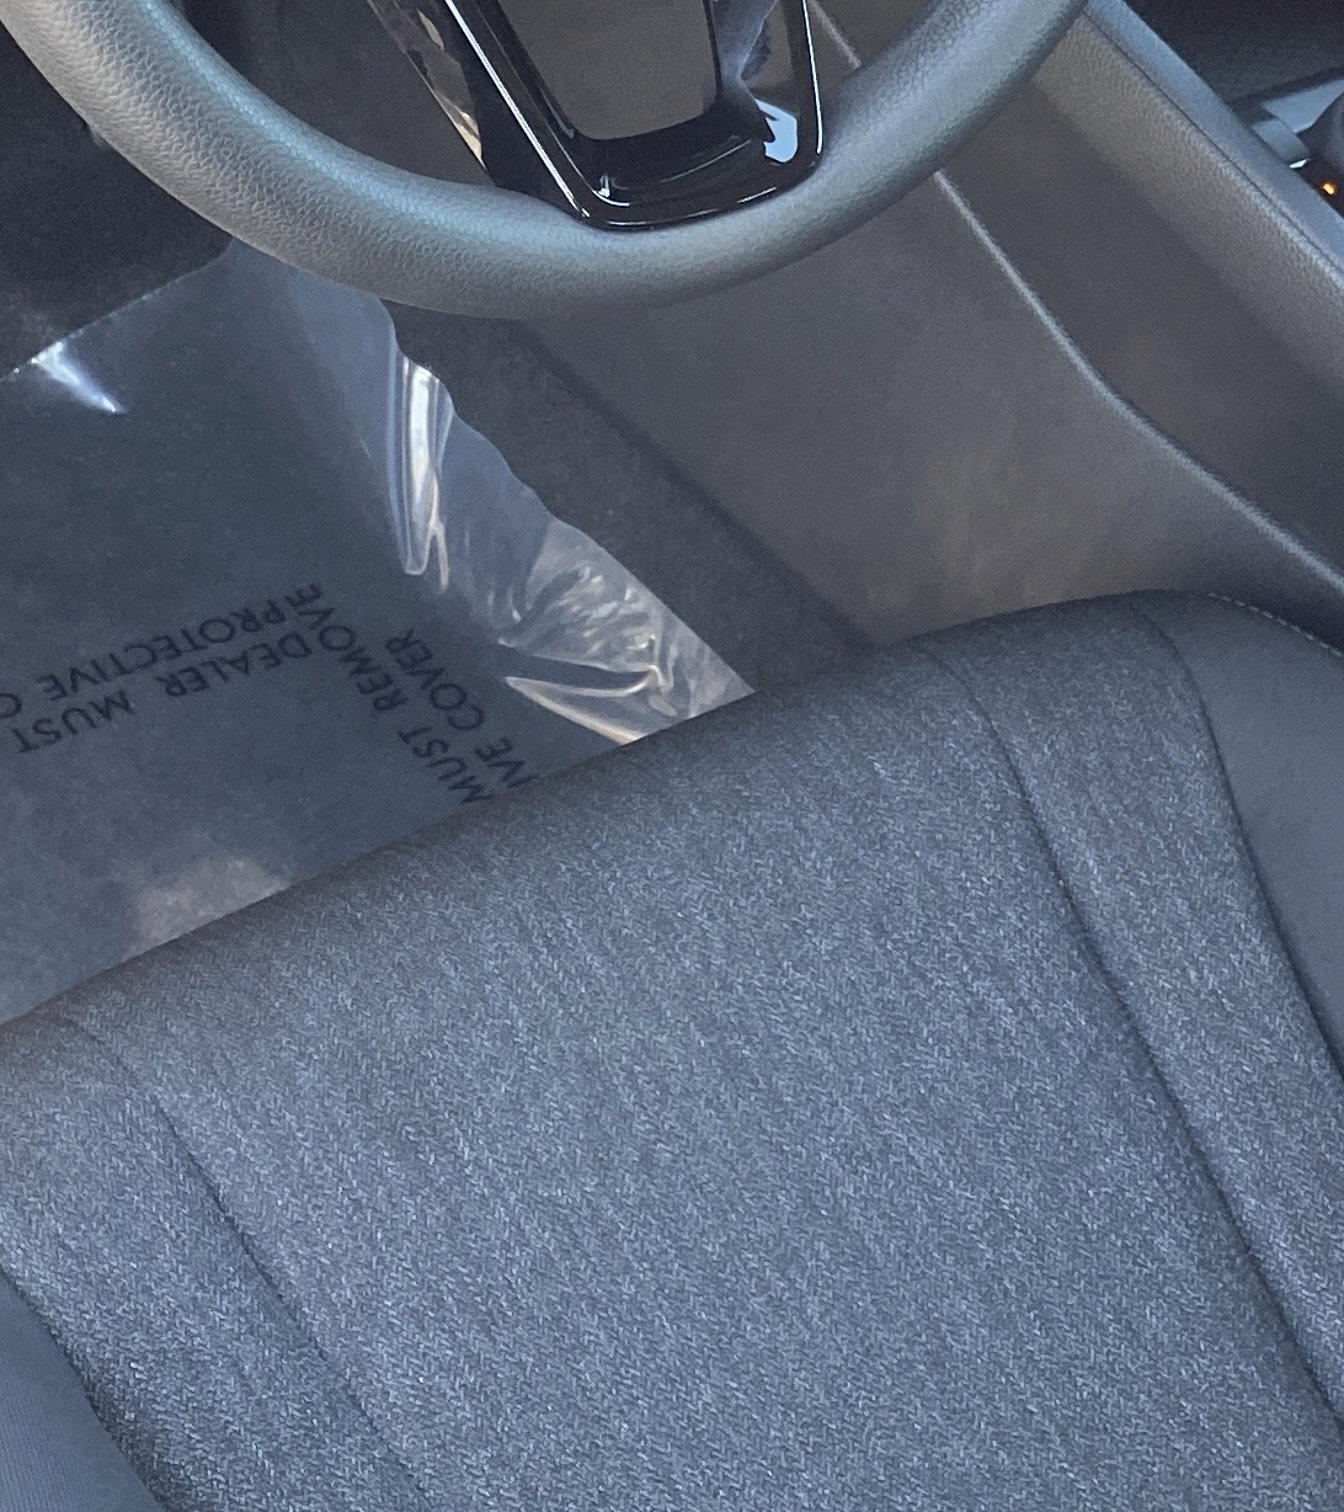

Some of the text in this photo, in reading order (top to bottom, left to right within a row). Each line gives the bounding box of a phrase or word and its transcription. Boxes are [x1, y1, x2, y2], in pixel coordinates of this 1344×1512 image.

[37, 598, 287, 701] PROTECTIVE
[155, 632, 312, 697] DEALER
[285, 583, 495, 804] MUST REMOVE
[385, 628, 484, 730] COVER
[12, 690, 134, 753] MUST
